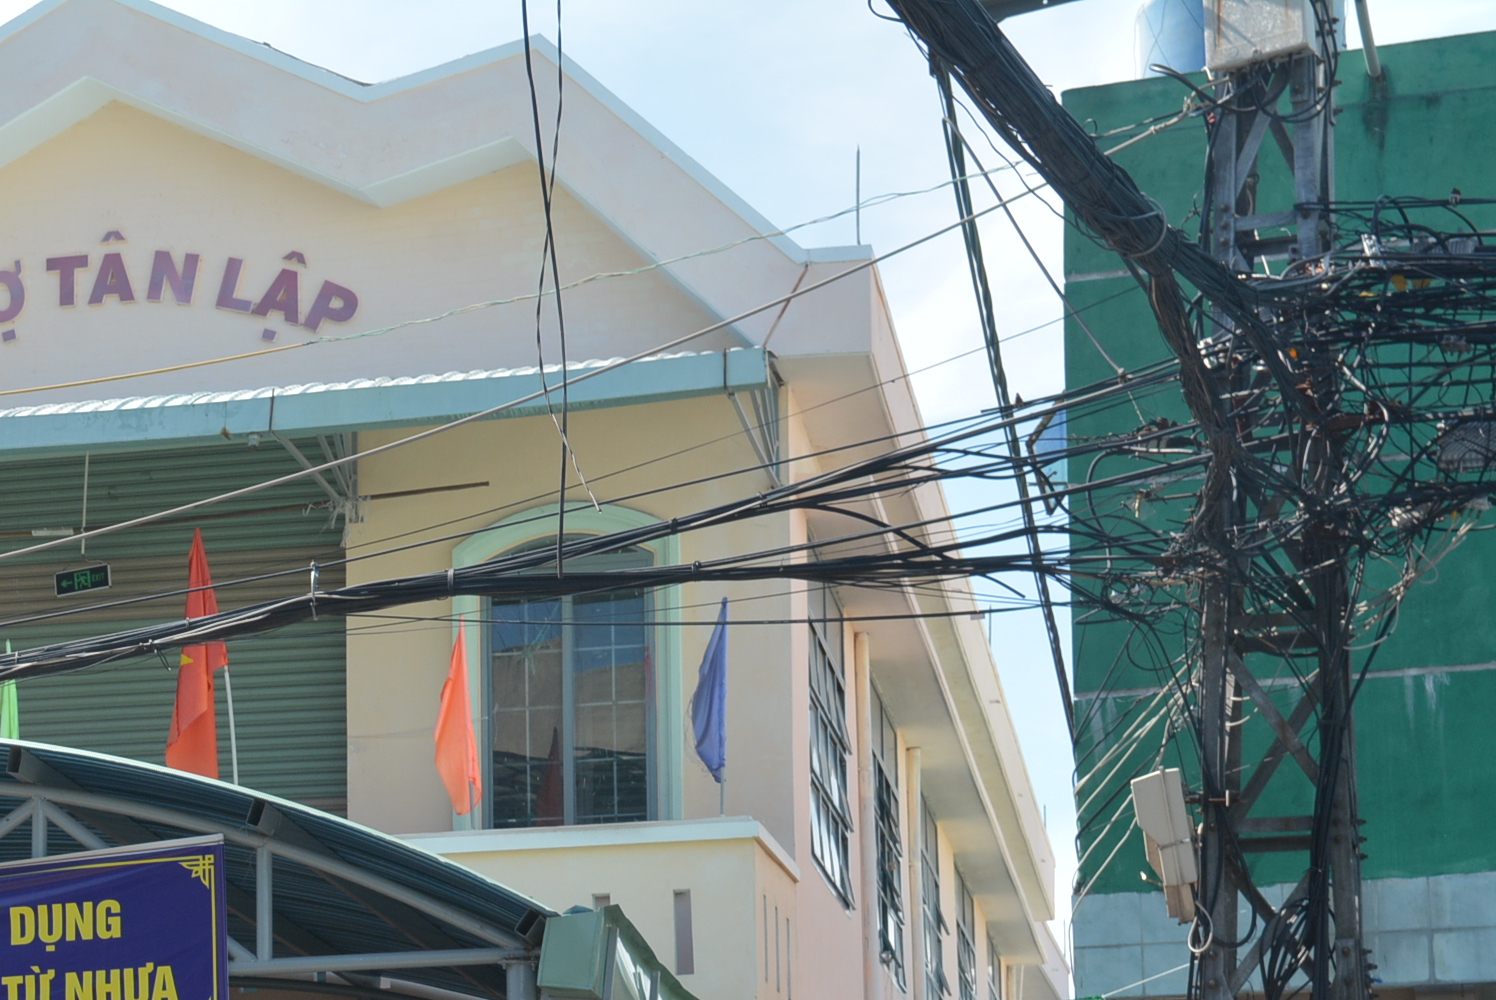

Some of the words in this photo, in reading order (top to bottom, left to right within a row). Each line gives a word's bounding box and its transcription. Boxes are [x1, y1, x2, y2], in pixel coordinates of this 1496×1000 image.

[45, 230, 201, 309] TÂN
[214, 250, 360, 343] LẬP
[91, 572, 106, 582] EXIT
[9, 899, 122, 952] DỤNG
